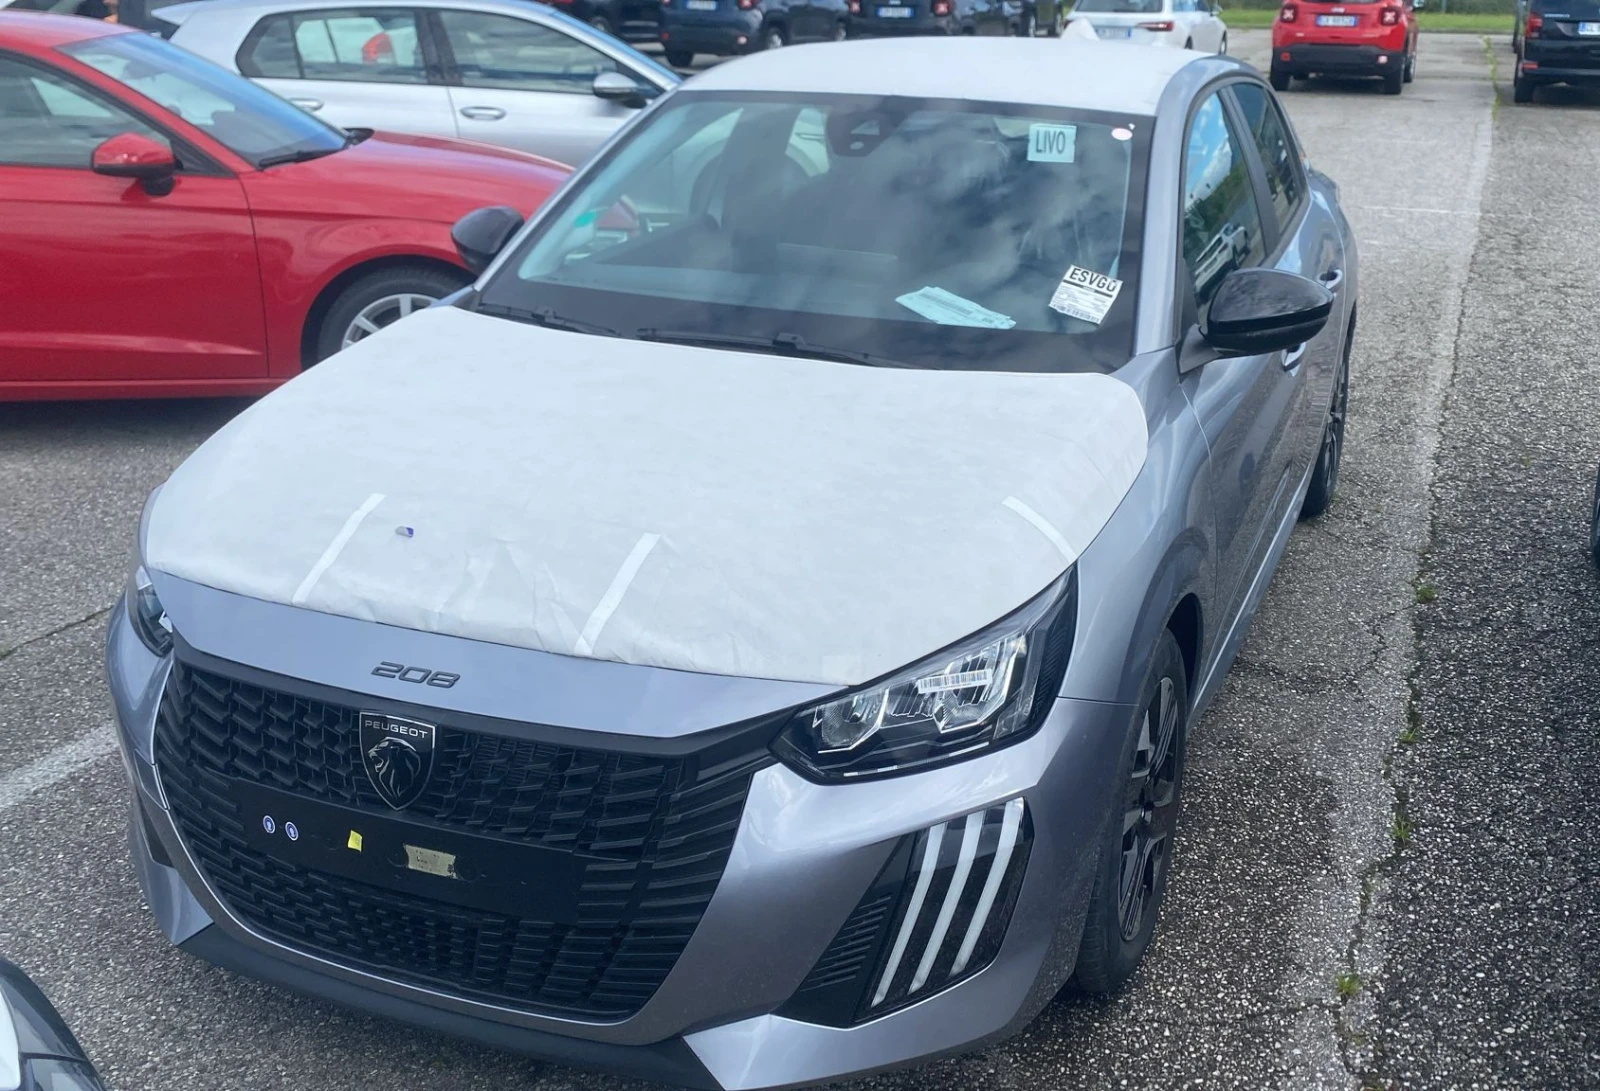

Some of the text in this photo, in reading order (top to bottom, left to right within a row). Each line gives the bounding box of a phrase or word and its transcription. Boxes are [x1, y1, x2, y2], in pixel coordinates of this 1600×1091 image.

[1035, 130, 1066, 155] LIVO
[371, 661, 461, 689] 208
[364, 720, 428, 739] PEUGEOT
